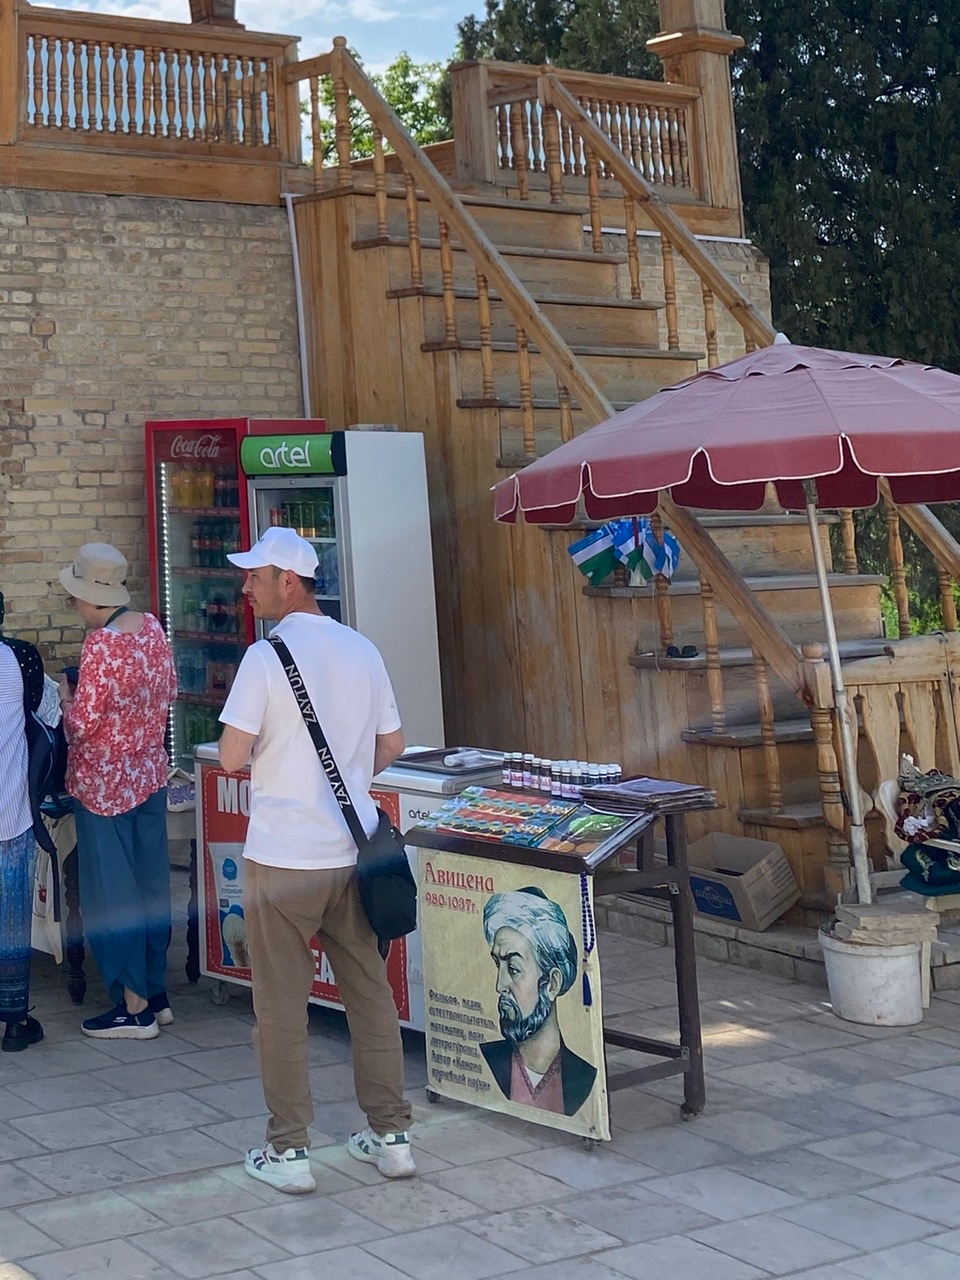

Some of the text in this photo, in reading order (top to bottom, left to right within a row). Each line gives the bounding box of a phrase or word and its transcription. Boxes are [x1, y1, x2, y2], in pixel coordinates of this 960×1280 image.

[170, 434, 222, 458] Coca-Cola
[260, 440, 312, 468] artel
[285, 664, 317, 725] ZAYTUN
[318, 746, 351, 810] ZAYTUN
[425, 862, 495, 893] Авицена
[425, 891, 479, 914] 980-1037г.
